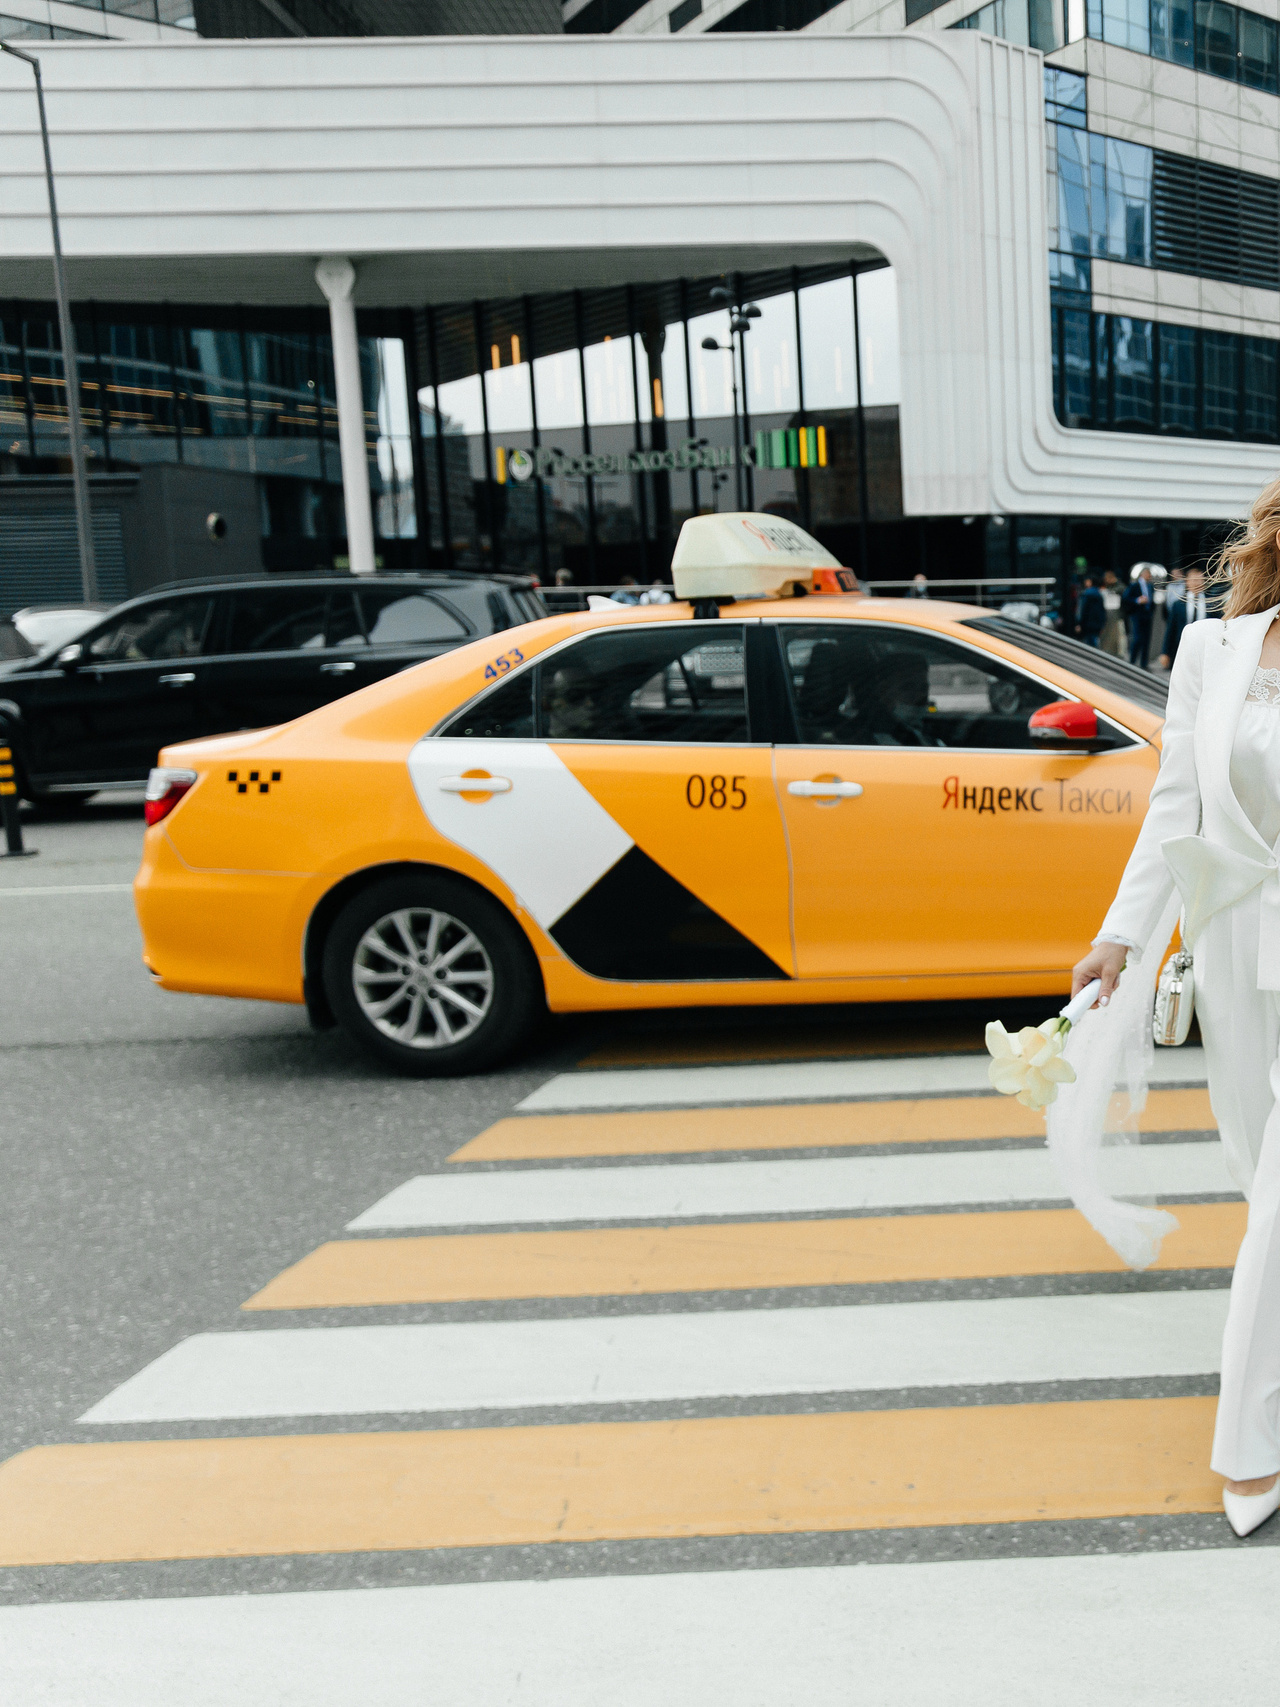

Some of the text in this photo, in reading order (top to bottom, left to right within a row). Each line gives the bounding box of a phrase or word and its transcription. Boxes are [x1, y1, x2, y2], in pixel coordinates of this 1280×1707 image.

[485, 648, 524, 679] 453
[686, 775, 747, 810] 085
[942, 776, 1132, 815] Яндекс Такси
